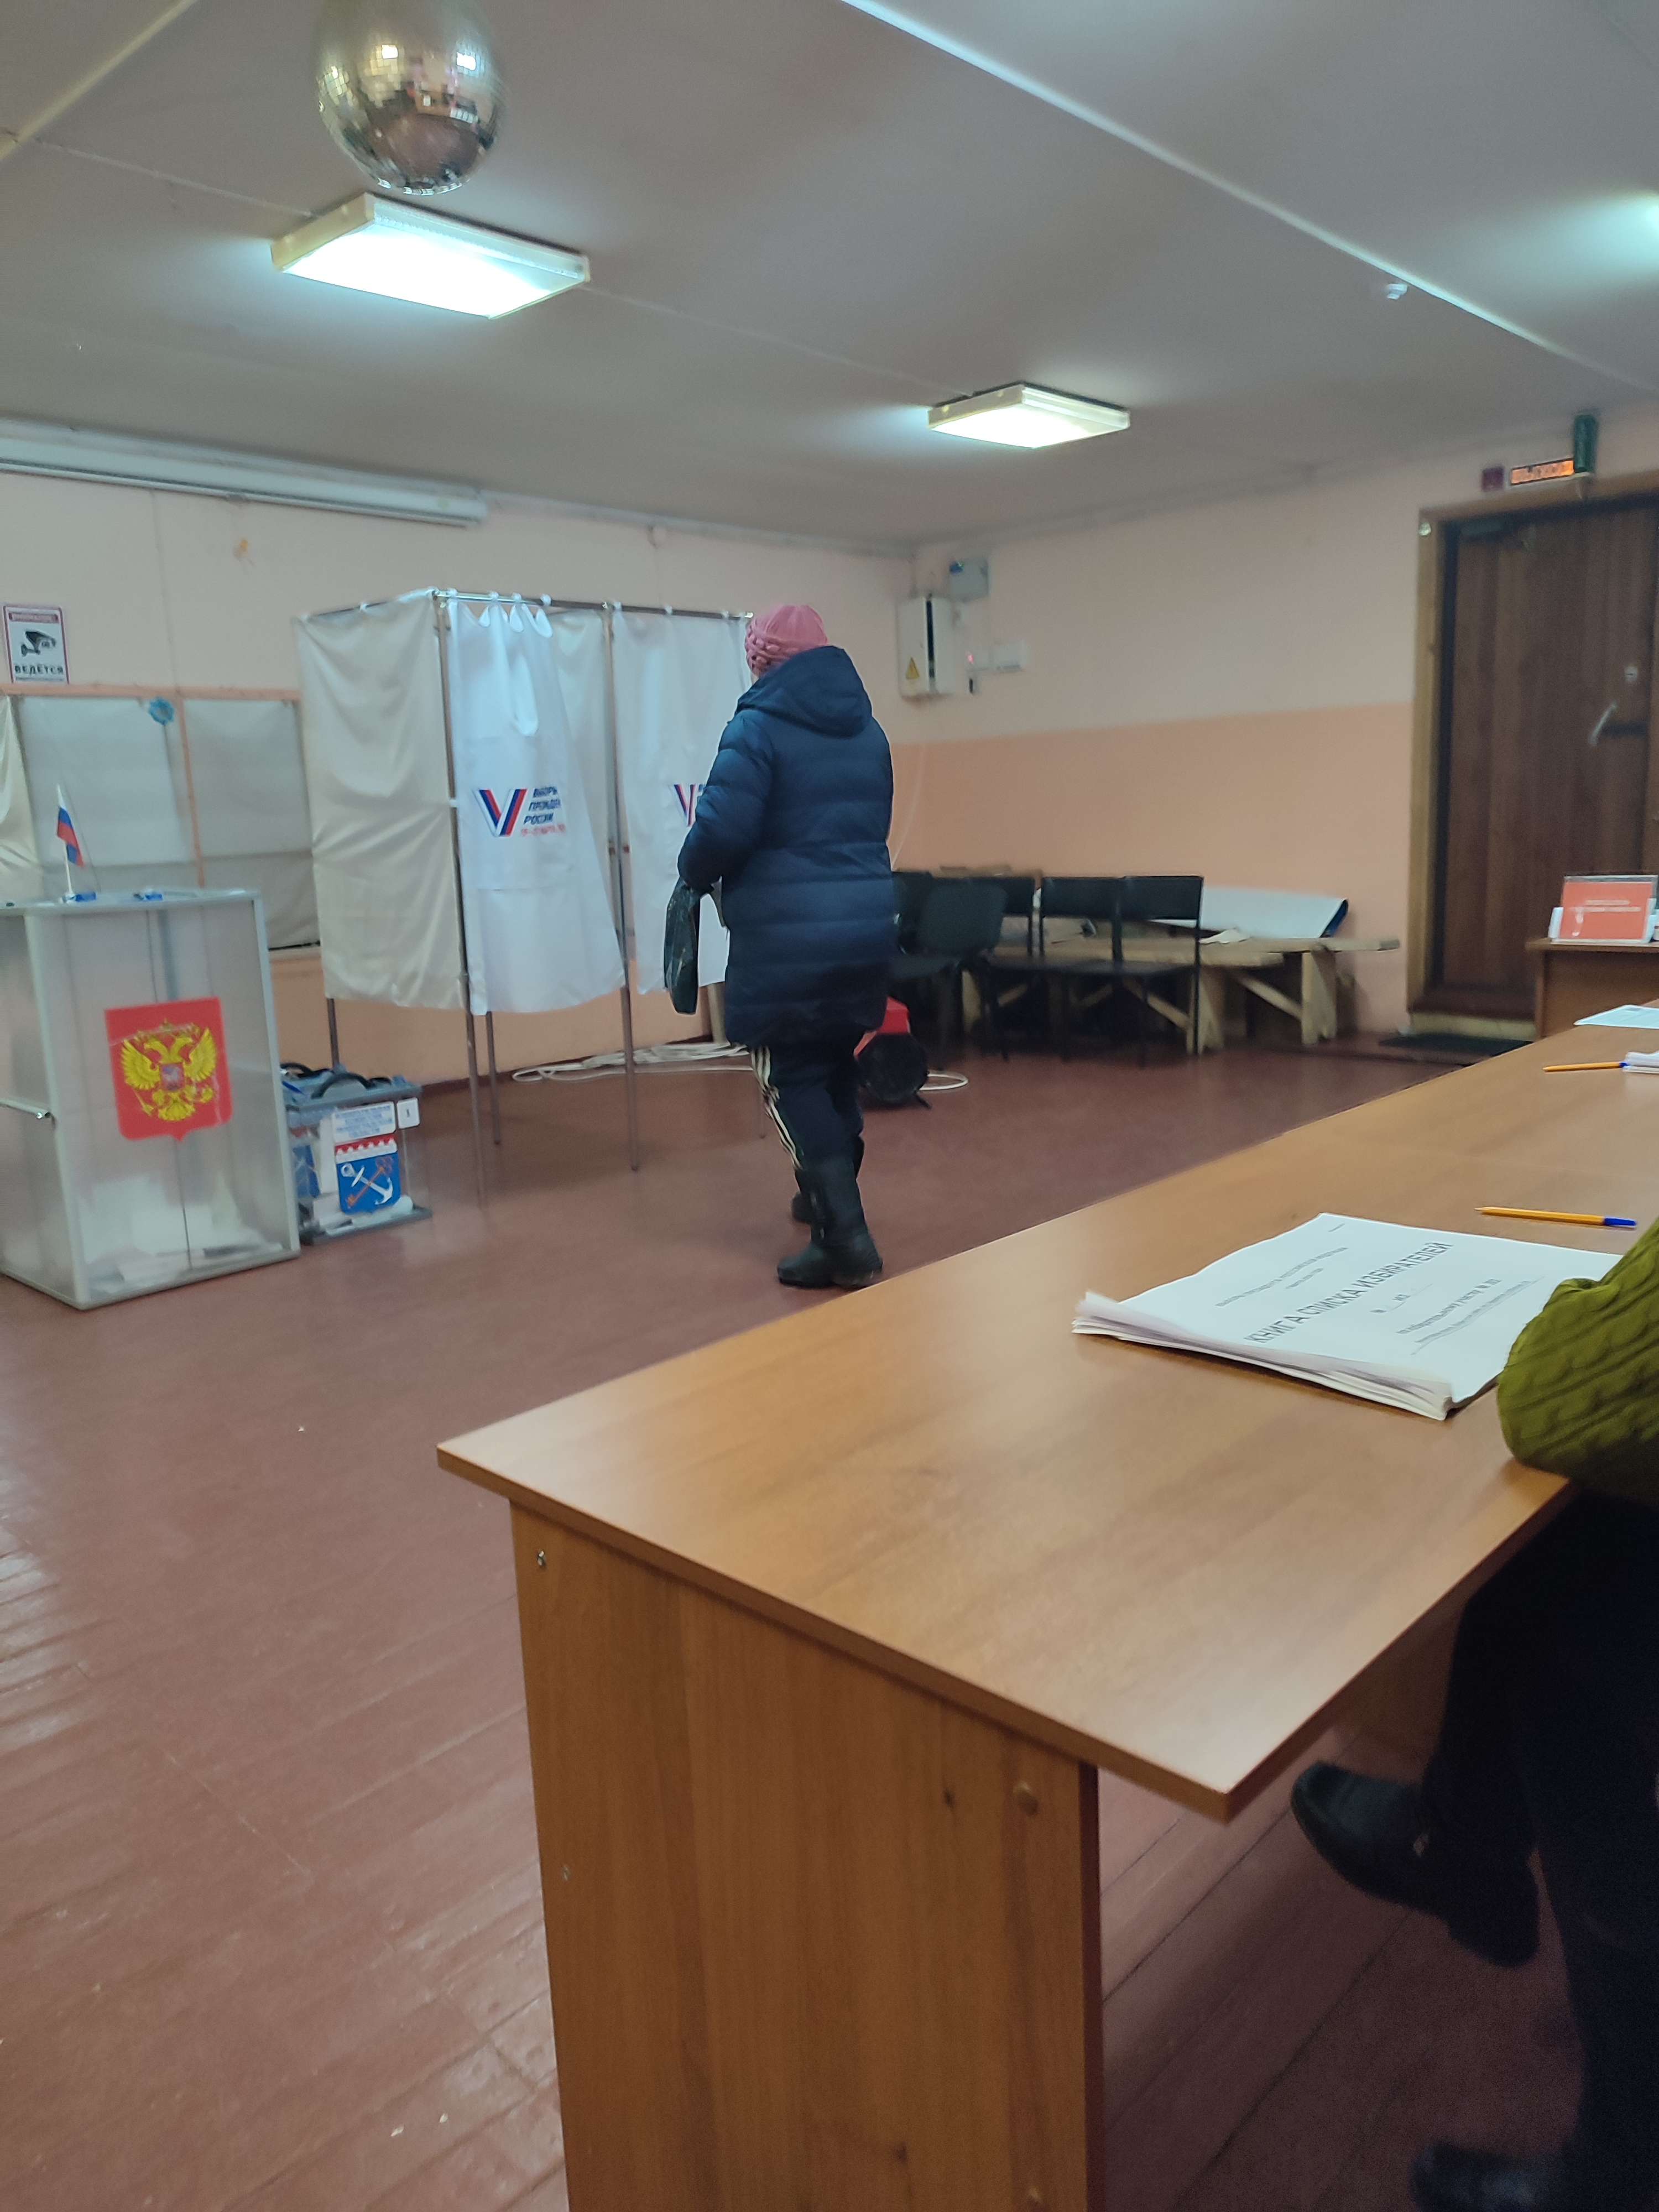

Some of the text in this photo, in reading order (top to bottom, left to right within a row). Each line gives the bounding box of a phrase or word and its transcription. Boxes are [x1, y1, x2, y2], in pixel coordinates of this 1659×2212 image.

[1244, 1316, 1311, 1343] КНИГА
[1296, 1288, 1368, 1316] СПИСКА
[1350, 1242, 1454, 1288] ИЗБИРАТЕЛЕЙ
